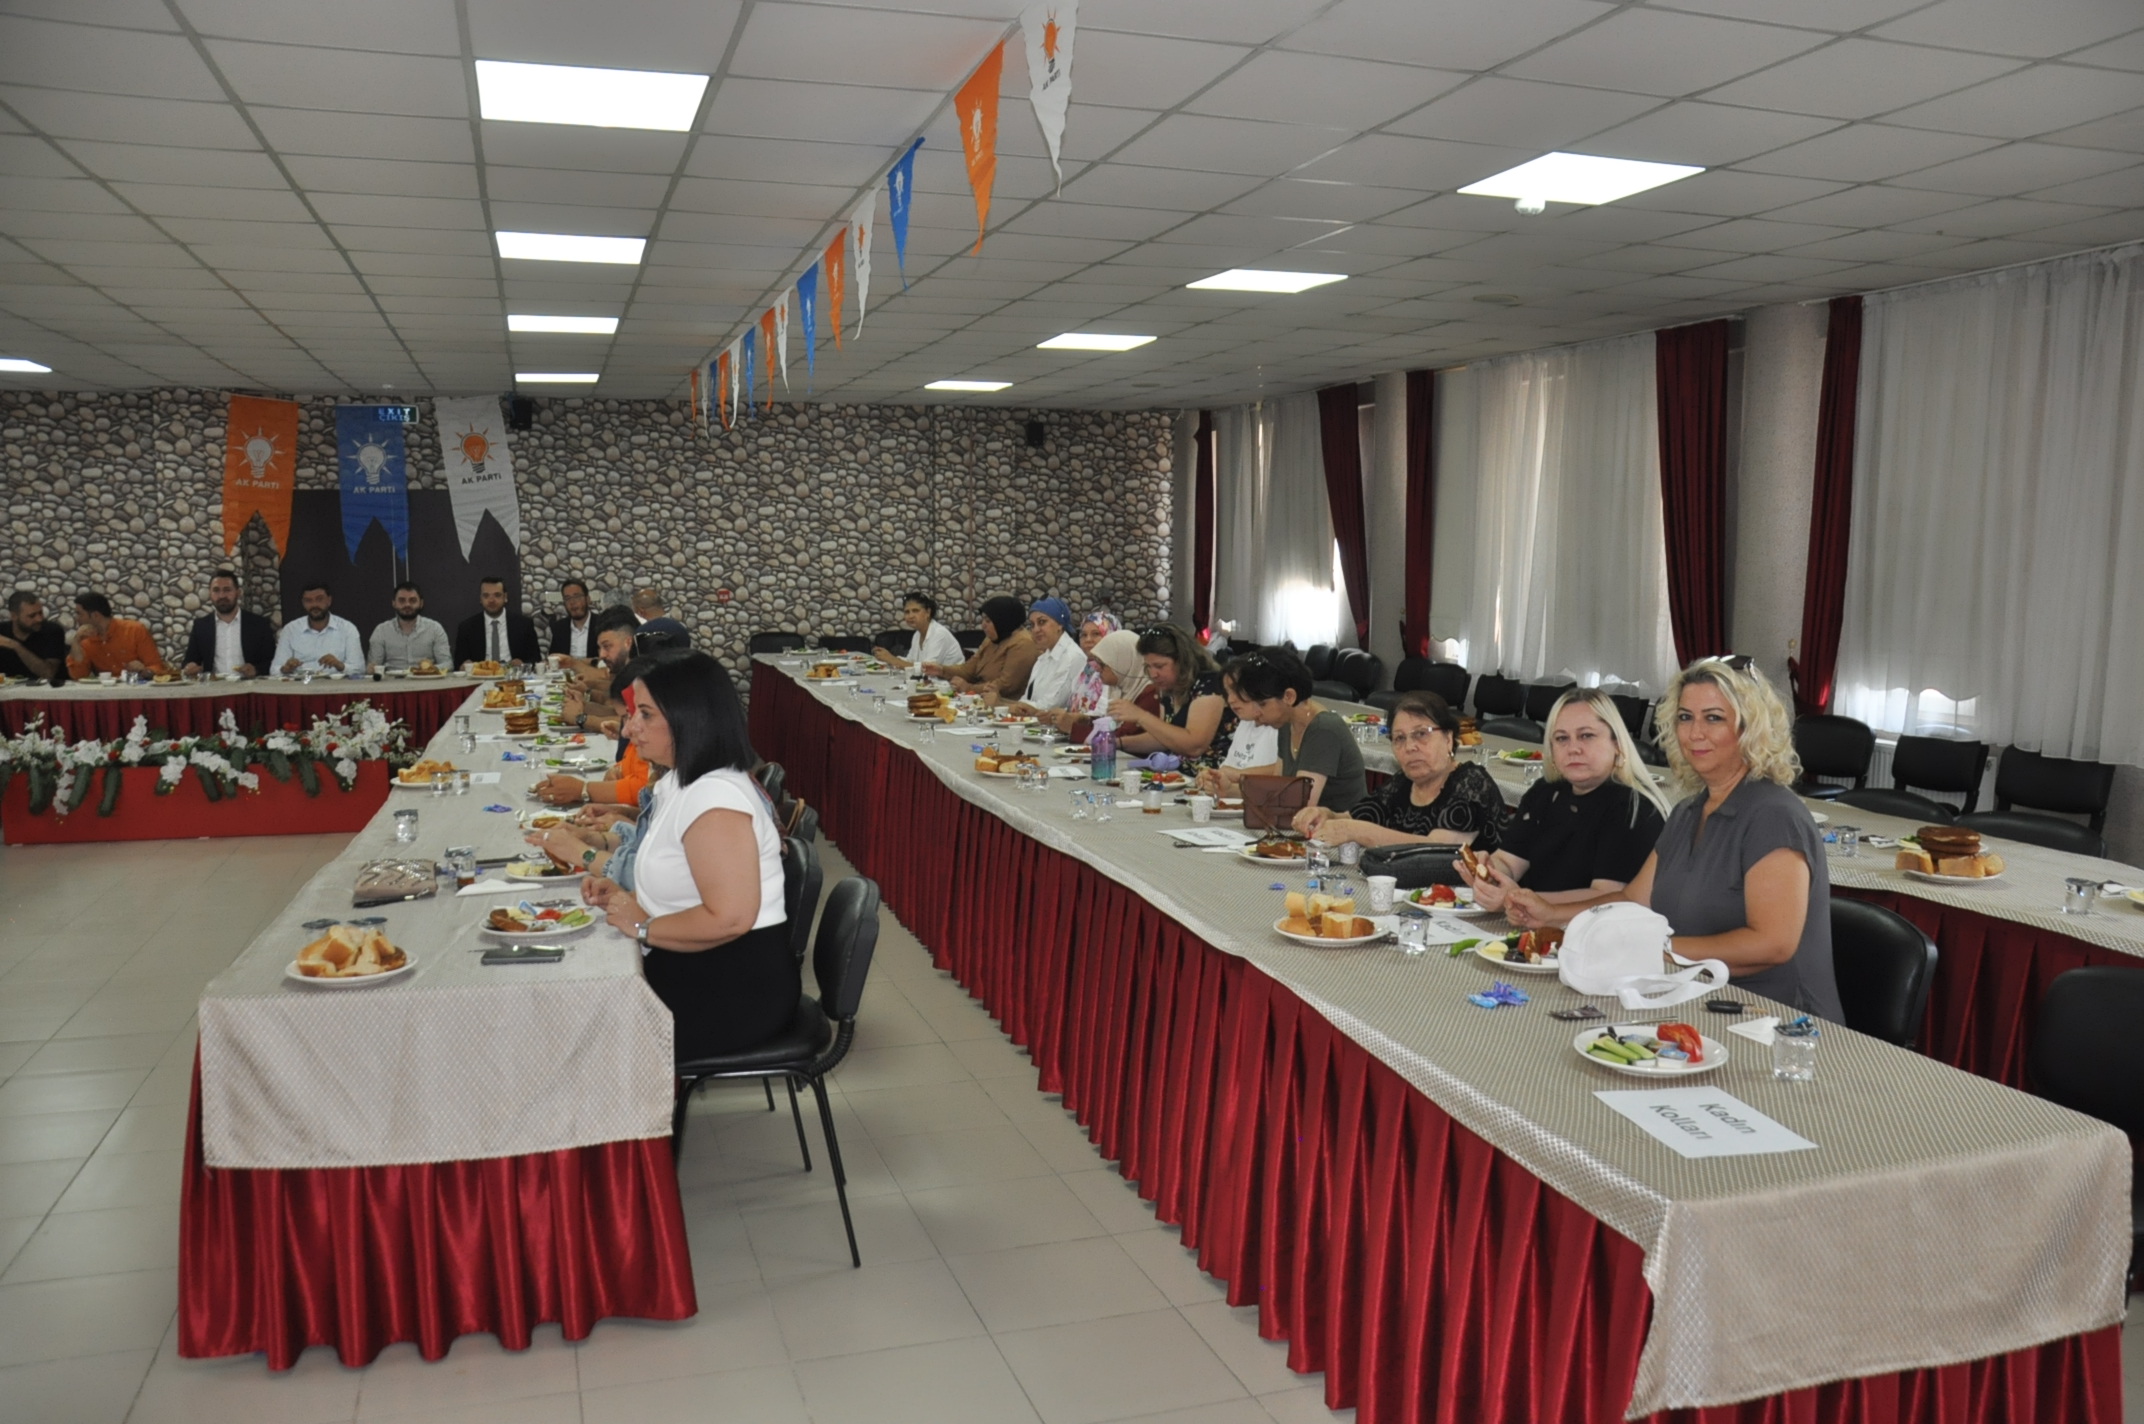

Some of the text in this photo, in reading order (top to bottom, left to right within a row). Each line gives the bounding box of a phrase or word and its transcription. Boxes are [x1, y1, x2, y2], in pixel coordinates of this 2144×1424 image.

[235, 478, 250, 486] AK
[461, 477, 474, 485] AK
[353, 486, 367, 494] AK
[1648, 1104, 1713, 1140] Kolları
[1698, 1103, 1757, 1134] Kadın
